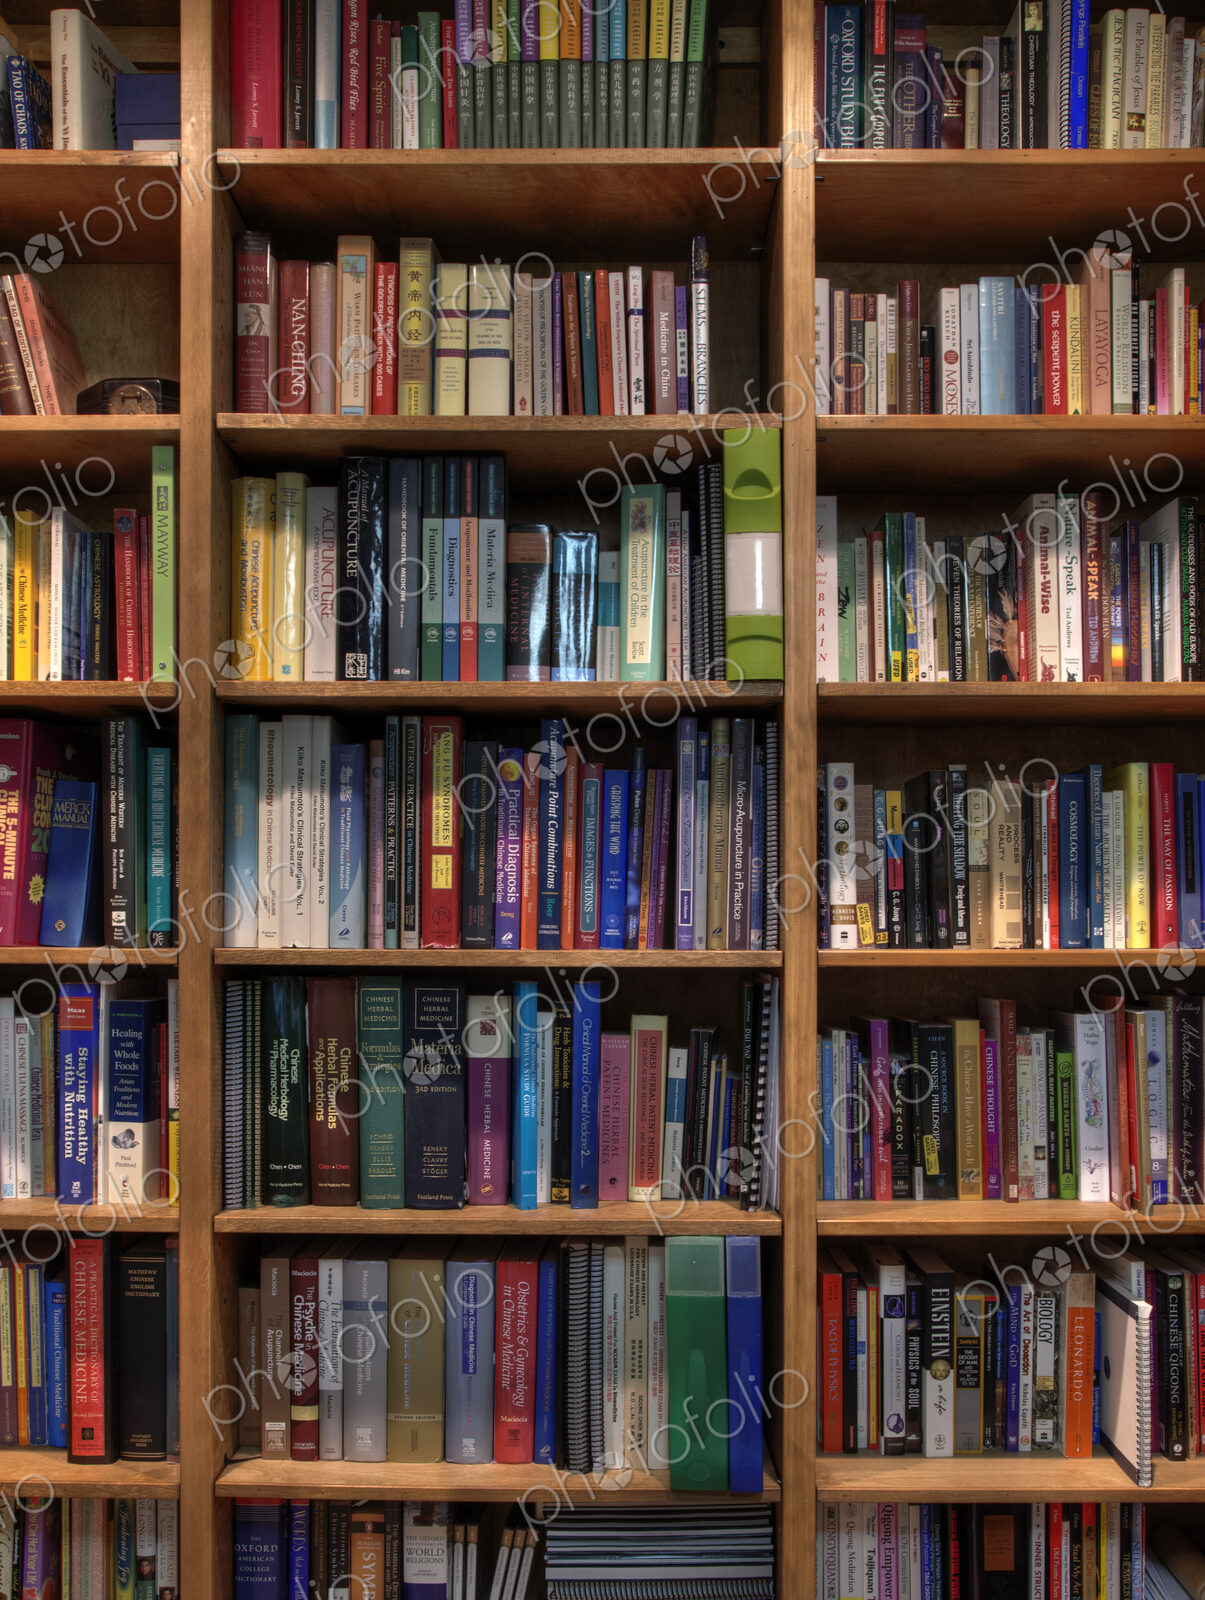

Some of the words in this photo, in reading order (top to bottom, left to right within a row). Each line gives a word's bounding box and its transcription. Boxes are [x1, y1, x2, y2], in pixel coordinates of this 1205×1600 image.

[375, 56, 387, 77] Five
[841, 19, 855, 73] OXFORD
[11, 69, 23, 88] TAO
[372, 80, 386, 114] Spirits
[16, 103, 28, 134] CHAOS
[841, 76, 855, 124] STUDY
[1001, 92, 1010, 148] THEOLOGY
[696, 288, 707, 327] STEMS
[291, 298, 306, 396] NAN-CHING
[660, 311, 669, 353] Medicine
[1069, 316, 1080, 374] KUNDALINI
[1095, 309, 1108, 387] LAYAYOGA
[661, 368, 670, 398] China
[696, 342, 708, 405] BRANCHES
[346, 470, 357, 578] ACUPUNCTURE
[464, 519, 472, 562] Acupuncture
[157, 514, 168, 578] MAYWAY
[240, 539, 248, 556] and
[250, 539, 260, 573] Chinese
[321, 507, 335, 620] ACUPUNCTURE
[428, 528, 438, 601] Fundamentals
[447, 537, 457, 597] Diagnostics
[486, 528, 496, 568] Materia
[630, 538, 640, 579] Treatment
[640, 538, 650, 592] Acupuncture
[1086, 500, 1099, 600] ANIMAL-SPEAK
[18, 575, 27, 603] Chinese
[239, 559, 248, 612] Moxibustion
[486, 571, 496, 608] Medica
[952, 555, 961, 584] SEVEN
[1039, 525, 1051, 614] Animal-Wise
[18, 604, 27, 635] Medicine
[250, 574, 260, 631] Acupuncture
[630, 594, 639, 628] Children
[640, 605, 649, 618] the
[953, 585, 961, 627] THEORIES
[955, 640, 963, 680] RELIGION
[264, 729, 276, 807] Rheumatology
[407, 728, 415, 774] PATTERNS
[53, 801, 90, 813] MERCK
[296, 768, 304, 817] Matsumoto's
[387, 781, 396, 826] PATTERNS
[406, 783, 414, 829] PRACTICE
[442, 776, 450, 844] SYNDROMES:
[547, 790, 559, 819] Point
[610, 785, 621, 819] GRASPING
[713, 760, 725, 837] Auriculotherapy
[296, 819, 304, 849] Clinical
[507, 788, 520, 840] Practical
[586, 817, 595, 852] IMAGES
[610, 821, 620, 834] THE
[735, 780, 746, 869] Micro-Acupuncture
[1068, 800, 1078, 864] COSMOLOGY
[1163, 818, 1171, 837] THE
[387, 836, 395, 881] PRACTICE
[546, 820, 558, 889] Combinations
[610, 836, 620, 855] WIND
[714, 838, 724, 873] Manual
[954, 847, 966, 881] SHADOW
[1164, 838, 1172, 858] WAY
[295, 850, 304, 890] Strategies
[506, 844, 519, 903] Diagnosis
[584, 859, 594, 912] FUNCTIONS
[546, 898, 555, 917] Ross
[734, 881, 743, 920] Practice
[1165, 874, 1173, 910] PASSION
[892, 906, 900, 922] Jung
[111, 1029, 143, 1039] Healing
[648, 1036, 658, 1070] CHINESE
[65, 1053, 74, 1086] with
[75, 1047, 88, 1103] Staying
[279, 1038, 289, 1073] Medical
[290, 1049, 299, 1084] Chinese
[327, 1038, 338, 1074] Herbal
[985, 1047, 994, 1086] CHINESE
[267, 1050, 279, 1117] Pharmacology
[278, 1074, 290, 1121] Herbology
[313, 1051, 326, 1121] Applications
[326, 1078, 338, 1129] Formulas
[648, 1072, 657, 1103] HERBAL
[64, 1091, 74, 1159] Nutrition
[648, 1105, 657, 1134] PATENT
[987, 1088, 995, 1134] THOUGHT
[1148, 1079, 1158, 1144] LOGIC
[76, 1108, 89, 1165] Healthy
[483, 1139, 492, 1180] MEDICINE
[647, 1137, 656, 1180] MEDICINES
[74, 1261, 86, 1326] CHINESE
[271, 1267, 279, 1296] Maciocia
[468, 1276, 476, 1307] Diagnosis
[53, 1308, 61, 1349] Traditional
[304, 1302, 315, 1340] Psyche
[502, 1298, 514, 1340] Chinese
[517, 1281, 530, 1335] Obstetrics
[931, 1288, 950, 1357] EINSTEIN
[1038, 1299, 1053, 1344] BIOLOGY
[1169, 1294, 1178, 1349] CHINESE
[75, 1330, 86, 1404] MEDICINE
[501, 1341, 513, 1390] Medicine
[909, 1336, 920, 1370] PHYSICS
[1074, 1316, 1085, 1402] LEONARDO
[512, 1348, 527, 1408] Gynecology
[909, 1388, 919, 1409] SOUL
[1170, 1353, 1179, 1404] QIGONG
[234, 1544, 278, 1553] OXFORD
[846, 1521, 855, 1549] Qigong
